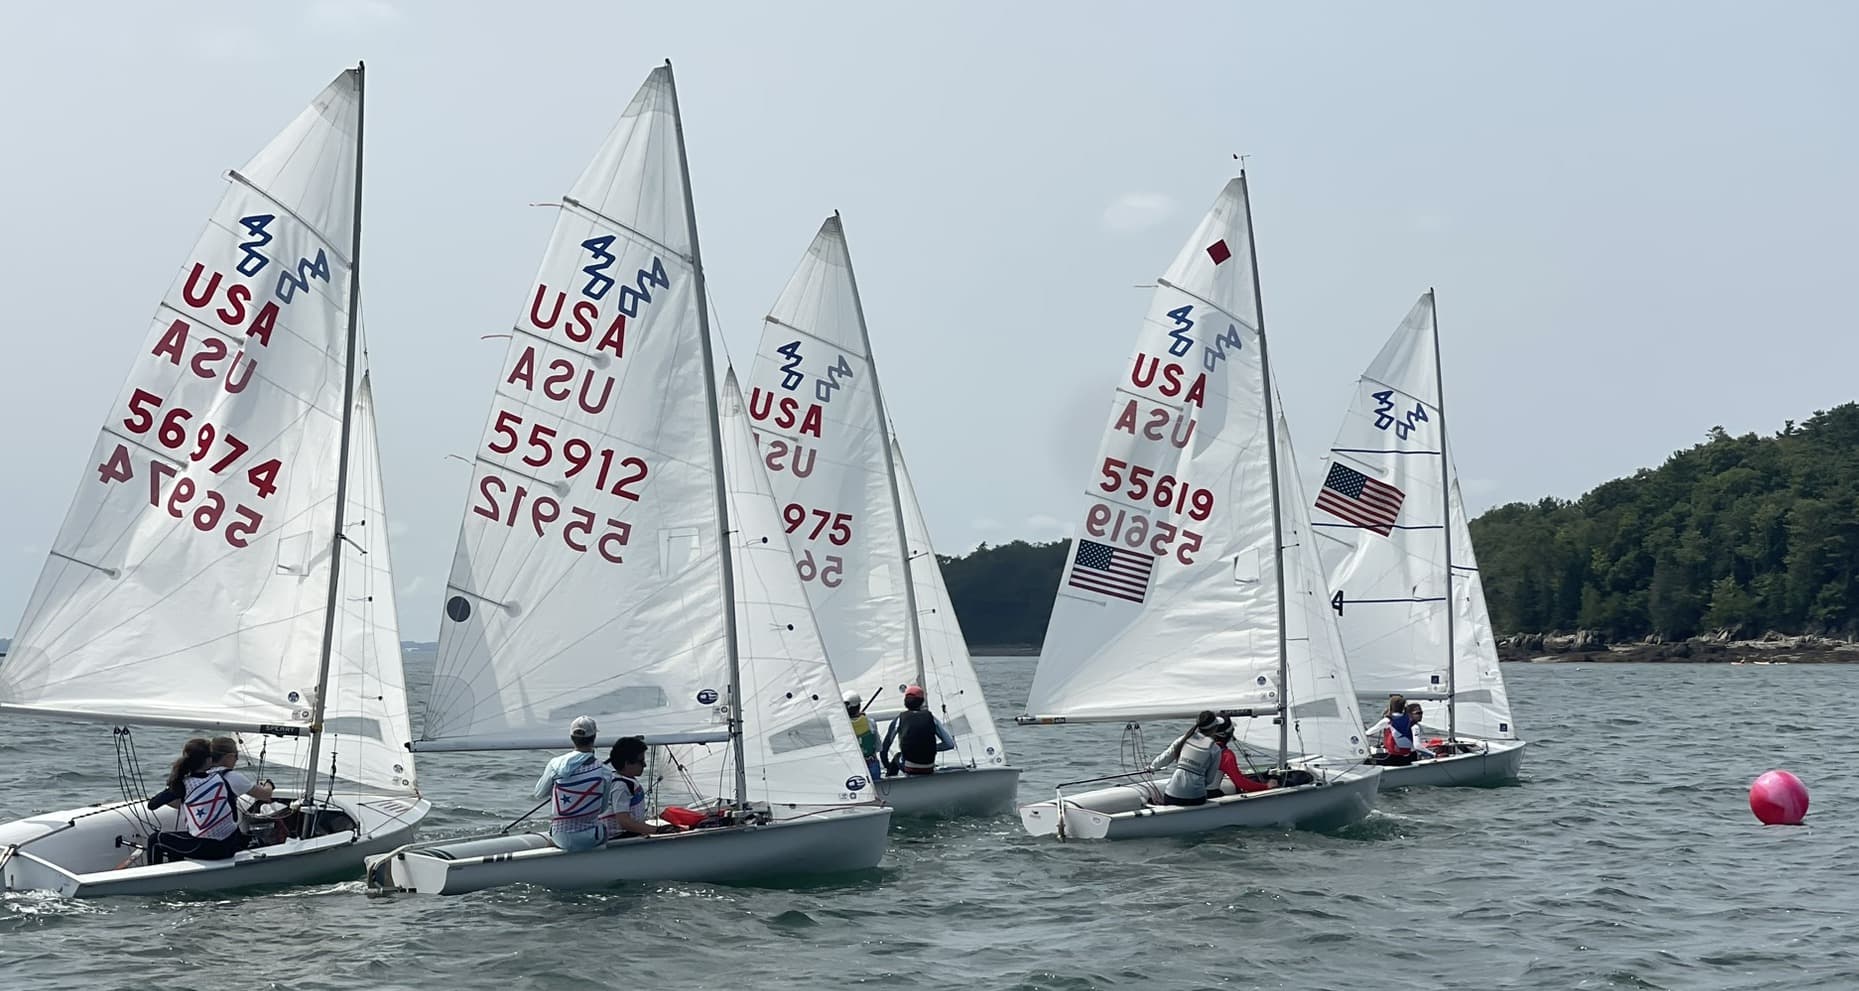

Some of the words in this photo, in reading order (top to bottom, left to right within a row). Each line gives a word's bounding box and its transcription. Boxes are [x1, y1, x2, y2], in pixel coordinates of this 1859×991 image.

[183, 263, 280, 347] USA
[530, 284, 626, 358] USA
[750, 387, 822, 438] USA
[1131, 353, 1206, 408] USA
[124, 388, 282, 499] 56974
[488, 410, 648, 502] 55912
[1100, 457, 1214, 521] 55619
[784, 503, 852, 545] 975
